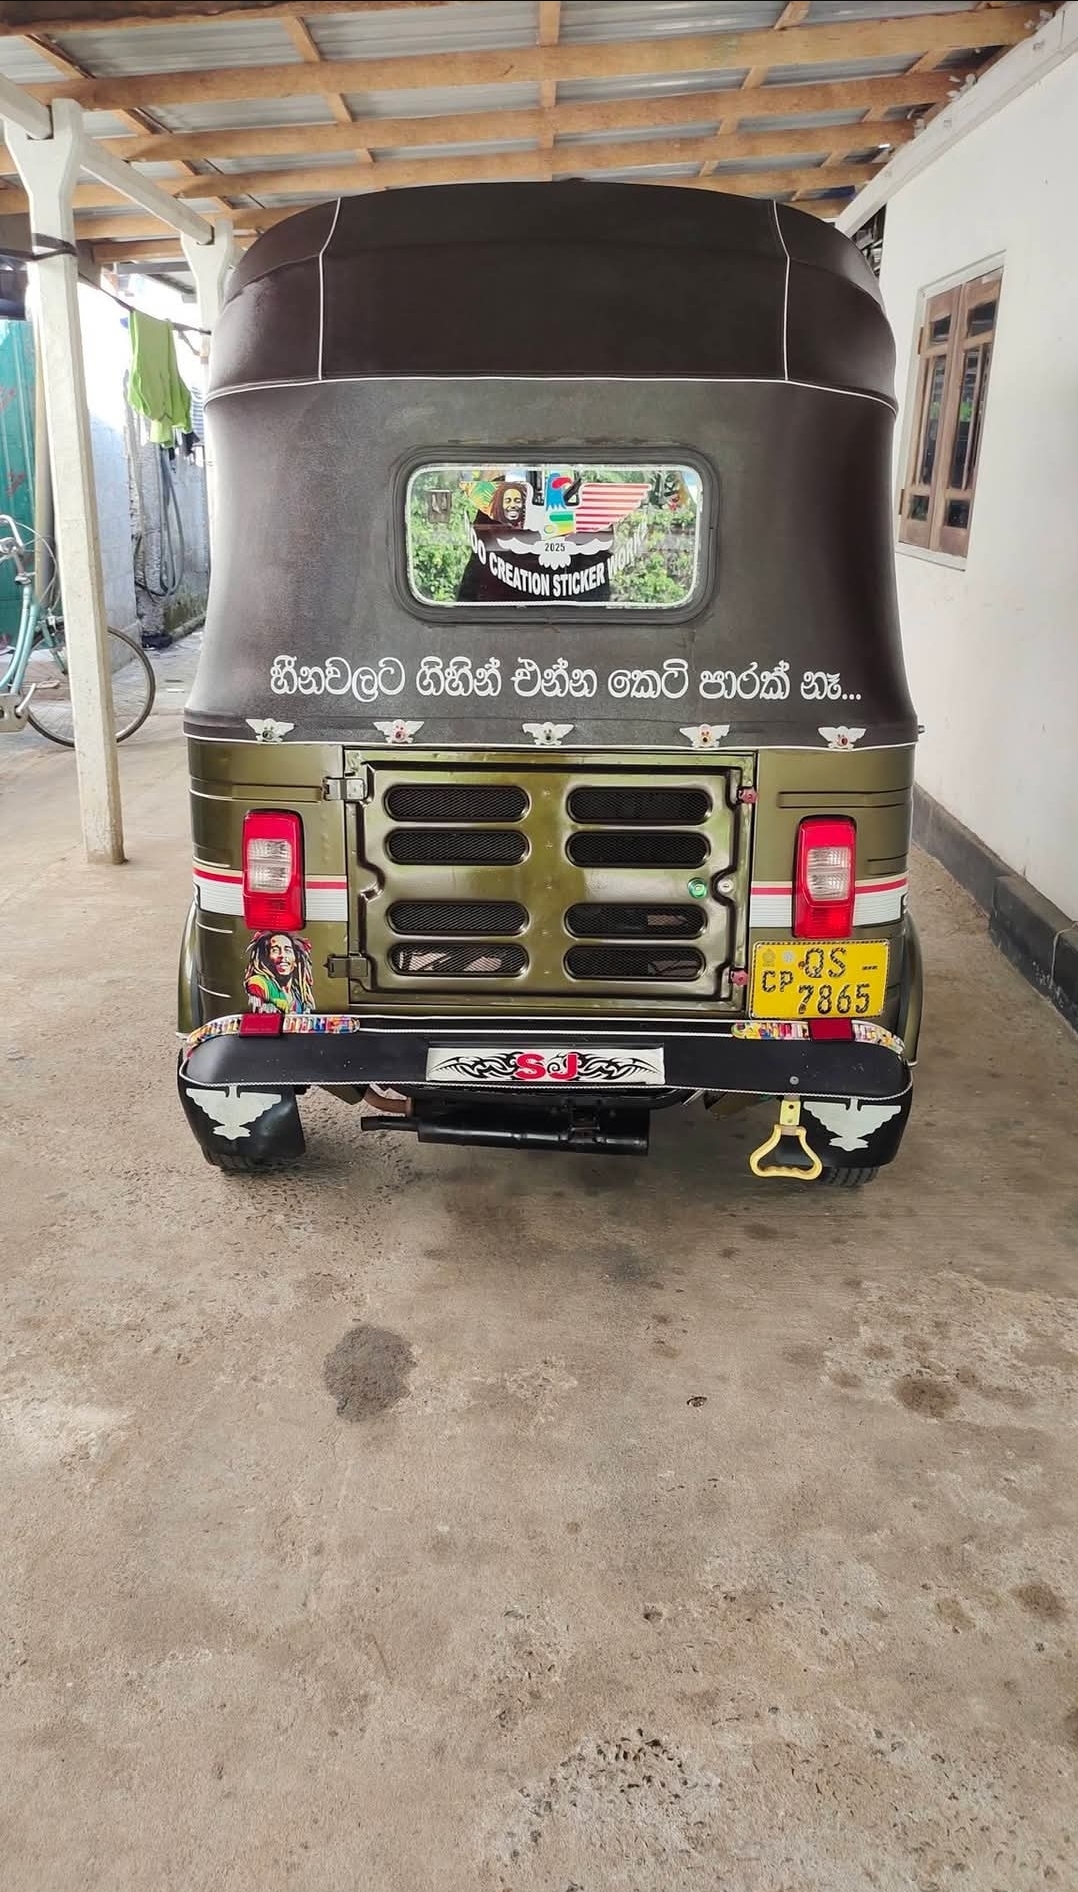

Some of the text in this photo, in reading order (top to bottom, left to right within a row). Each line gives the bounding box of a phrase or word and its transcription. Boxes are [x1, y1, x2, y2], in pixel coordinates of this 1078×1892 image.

[544, 542, 566, 552] 2025
[489, 552, 550, 597] CREATION
[552, 562, 605, 597] STICKER
[270, 655, 405, 702] හීනවලට
[416, 656, 501, 697] ගිහින්
[511, 657, 598, 697] එන්න
[608, 658, 689, 698] කෙටි
[699, 660, 790, 699] පාරක්
[804, 947, 847, 978] QS
[762, 970, 793, 992] CP
[798, 983, 870, 1014] 7865
[515, 1053, 578, 1080] SJ
